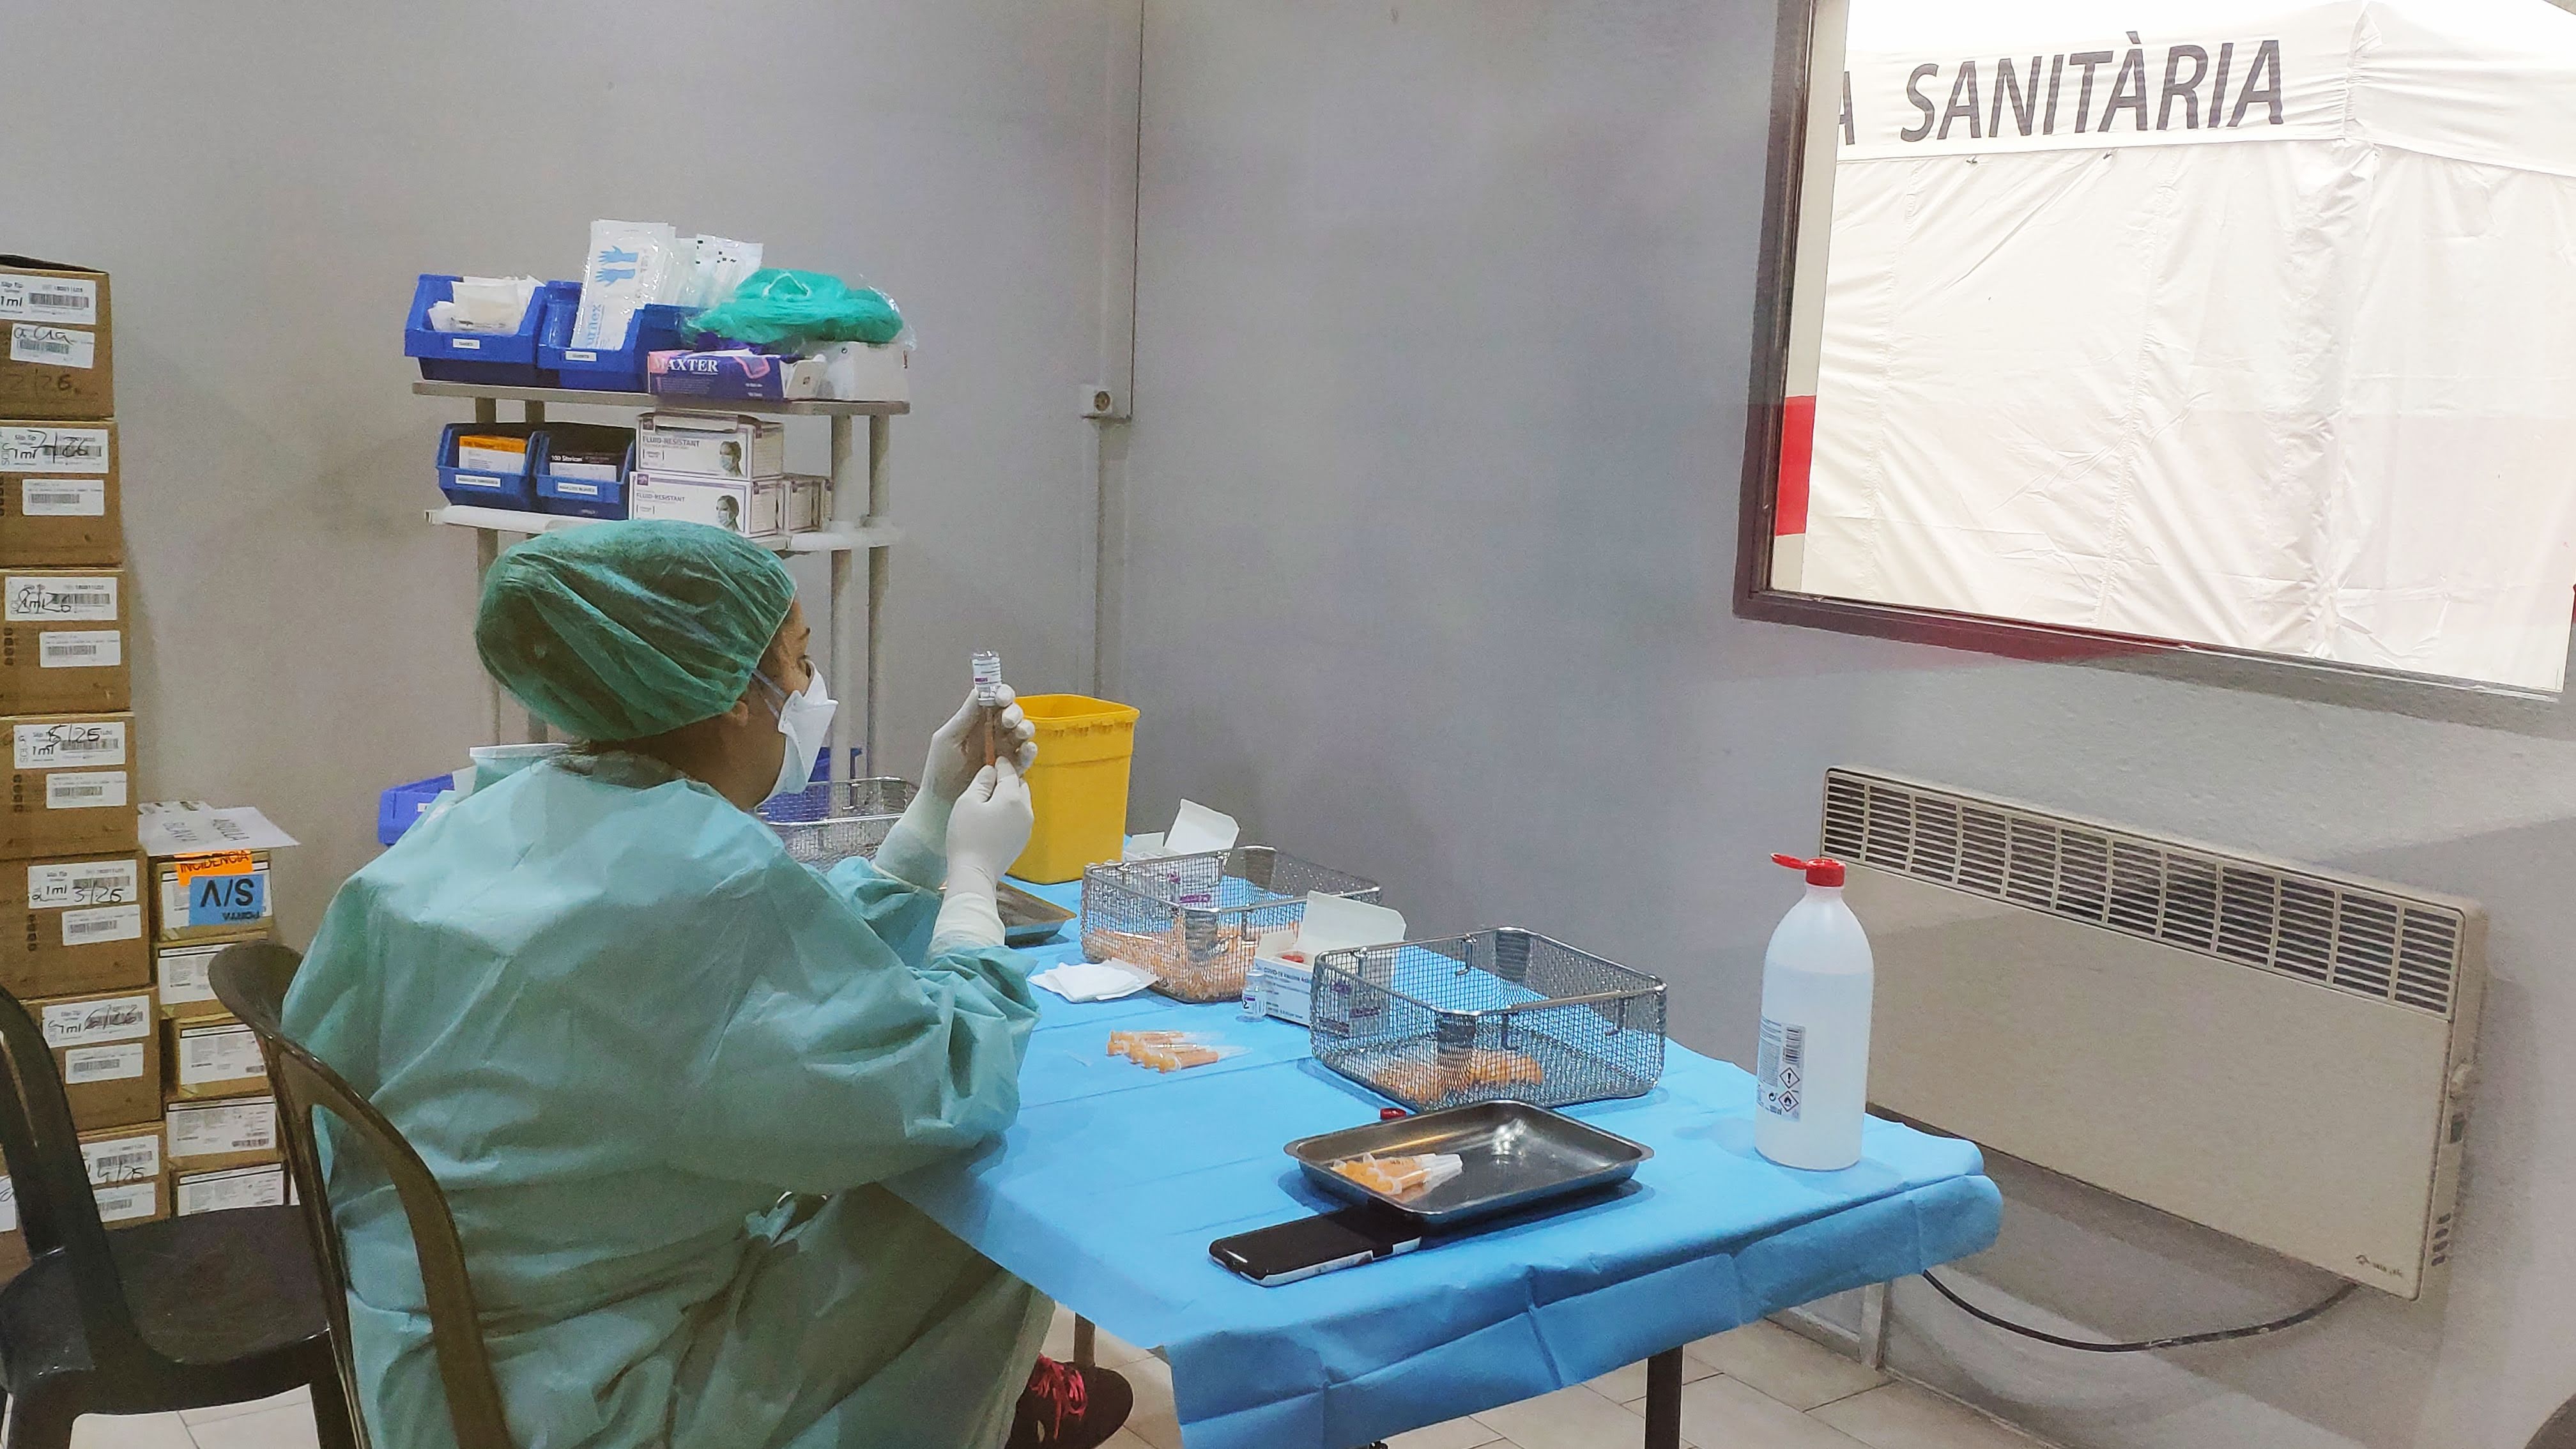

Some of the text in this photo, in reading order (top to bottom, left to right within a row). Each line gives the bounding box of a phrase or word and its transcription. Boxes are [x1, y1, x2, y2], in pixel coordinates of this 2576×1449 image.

[1901, 31, 2283, 142] SANITÀRIA
[654, 358, 719, 373] MAXTER
[46, 885, 67, 894] 1ml
